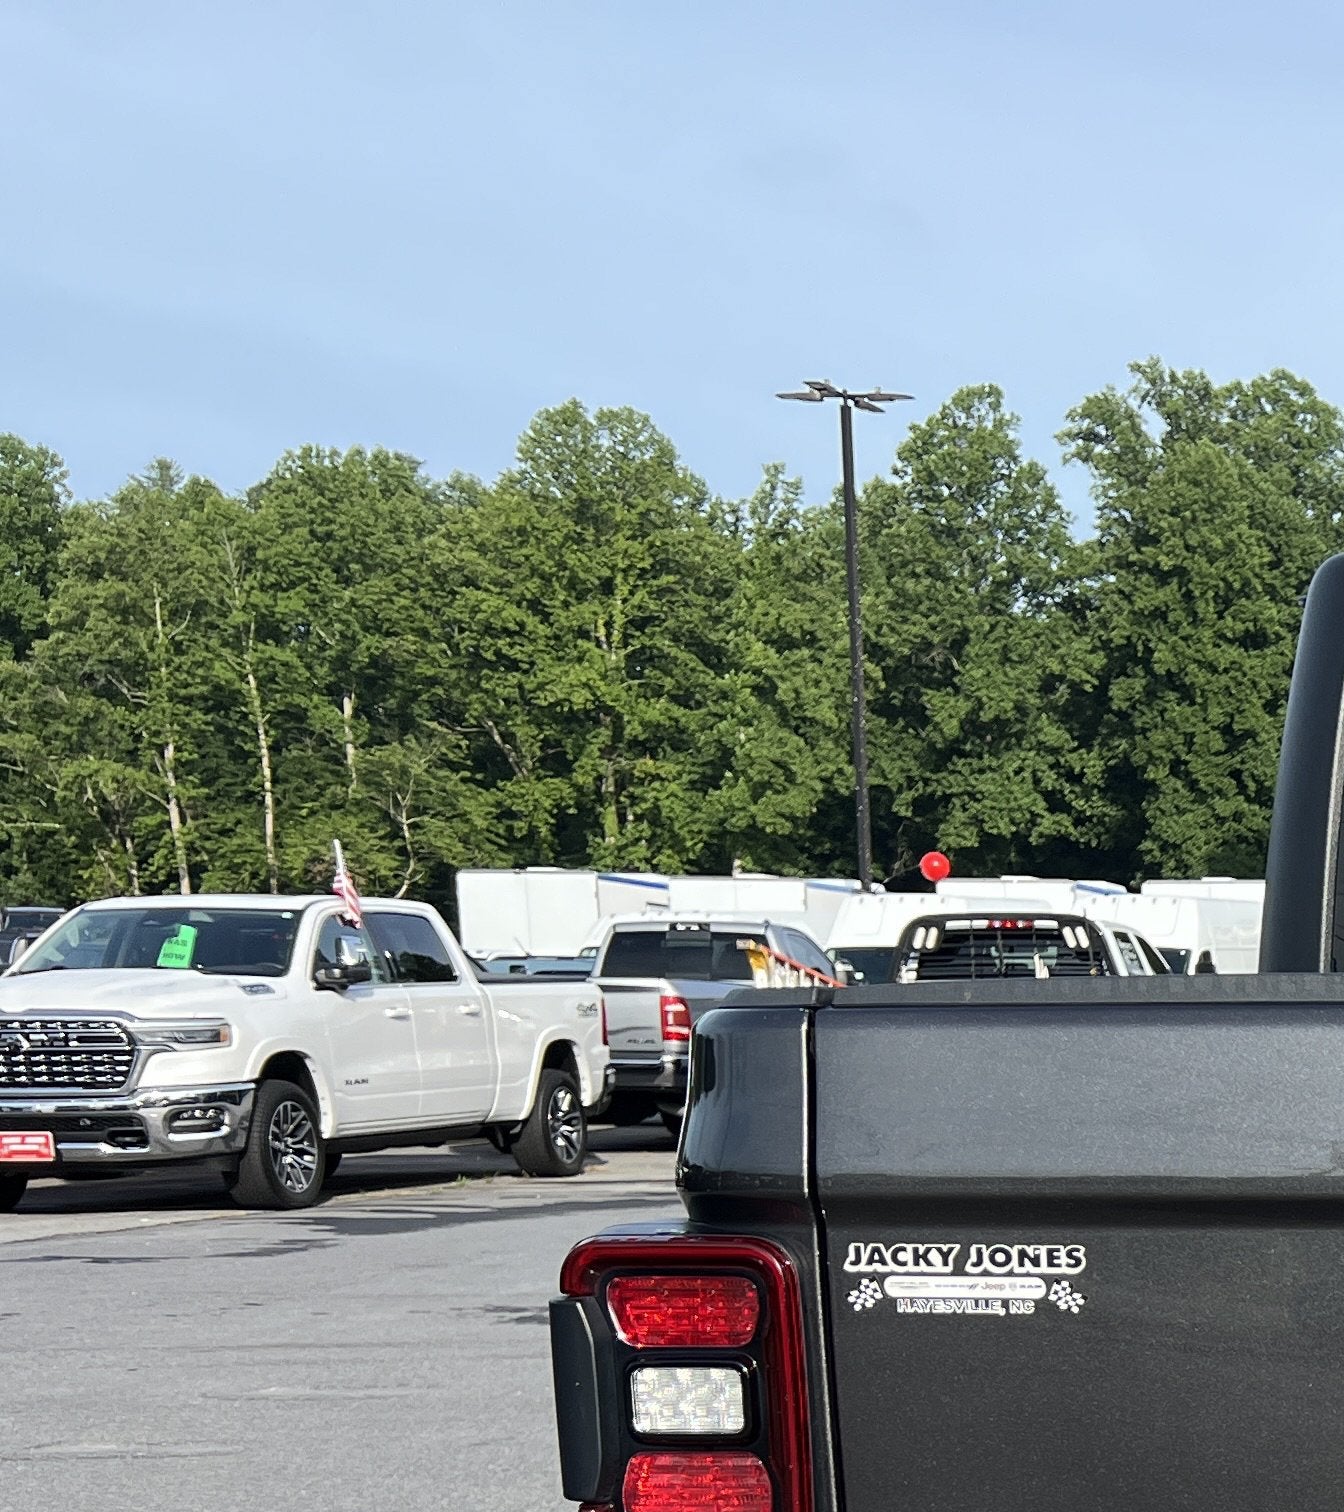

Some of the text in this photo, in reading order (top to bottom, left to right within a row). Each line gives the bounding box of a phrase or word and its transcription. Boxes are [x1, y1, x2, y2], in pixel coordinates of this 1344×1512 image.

[843, 1242, 1087, 1274] JACKY JONES
[896, 1298, 1035, 1316] HAYESVILLE, NC
